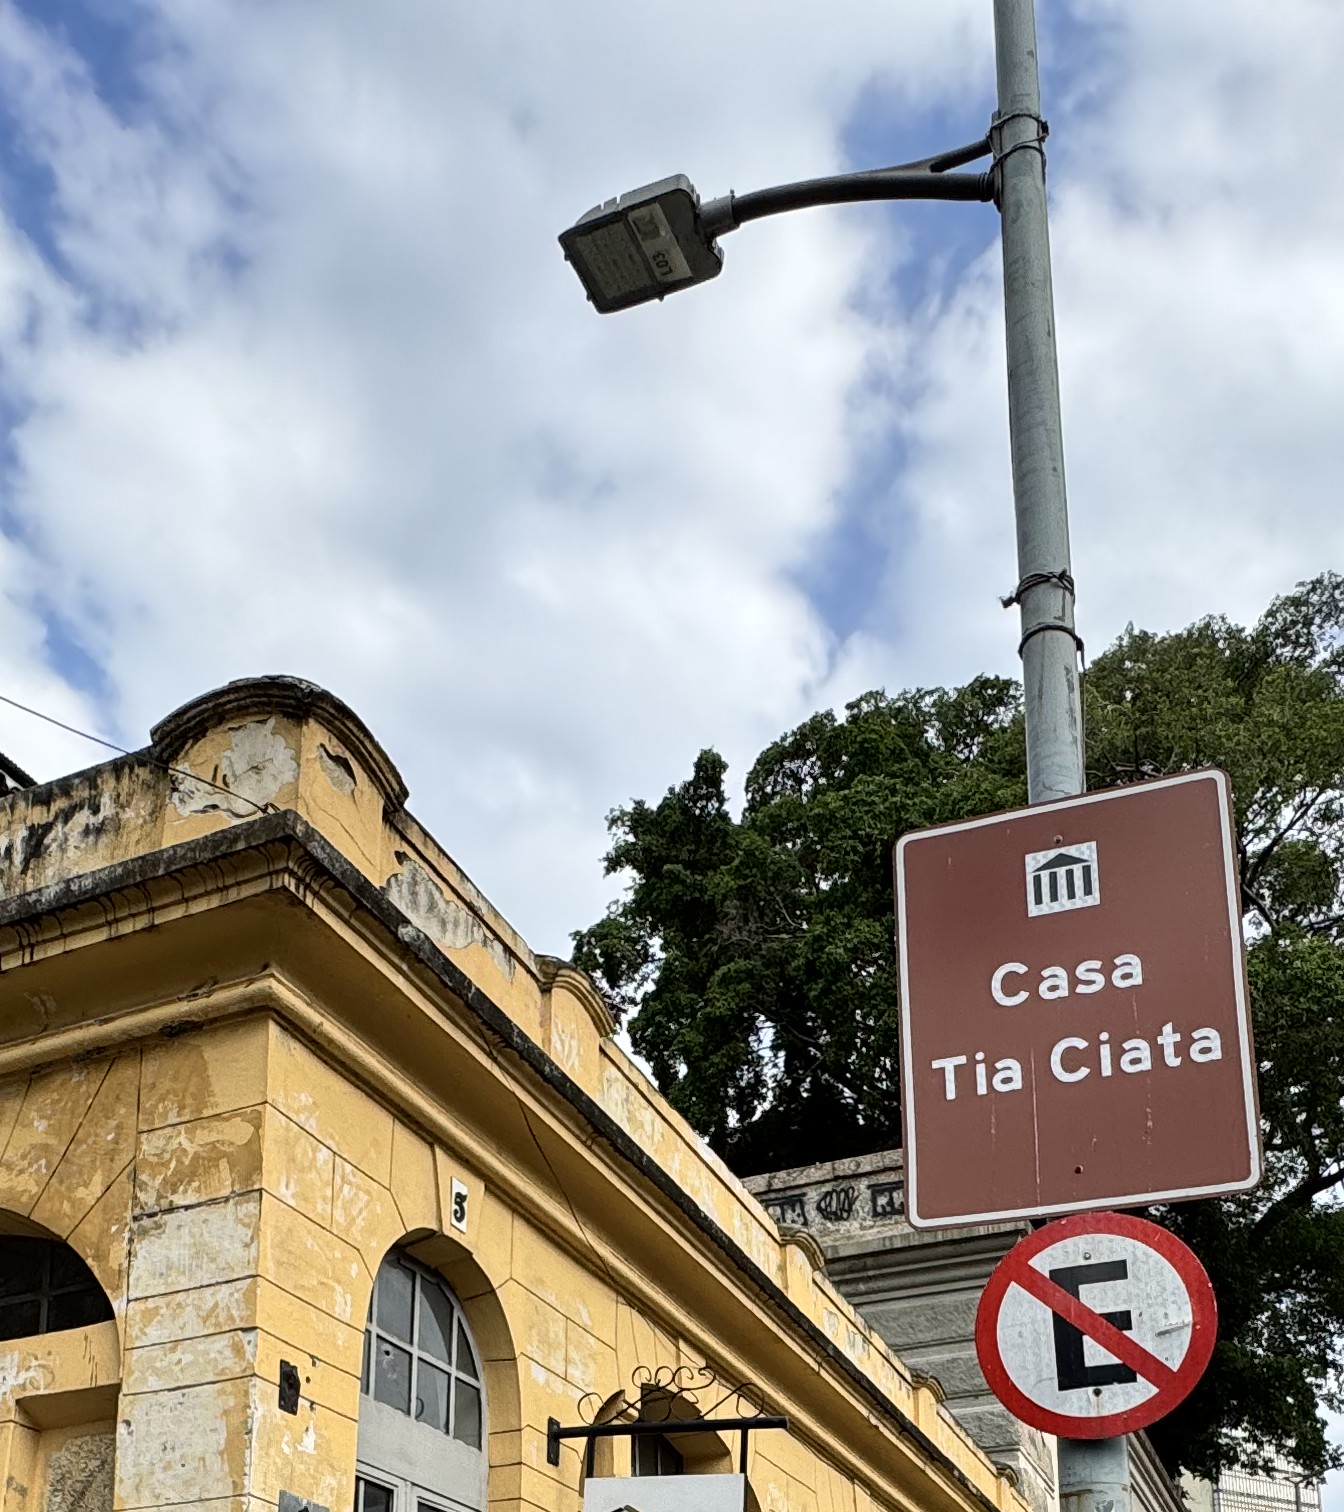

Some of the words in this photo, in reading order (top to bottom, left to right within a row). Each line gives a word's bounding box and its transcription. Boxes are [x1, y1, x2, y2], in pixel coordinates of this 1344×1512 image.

[990, 953, 1144, 1007] Casa
[931, 1051, 1023, 1101] Tia
[1050, 1021, 1222, 1083] Ciata
[1049, 1259, 1137, 1391] E
